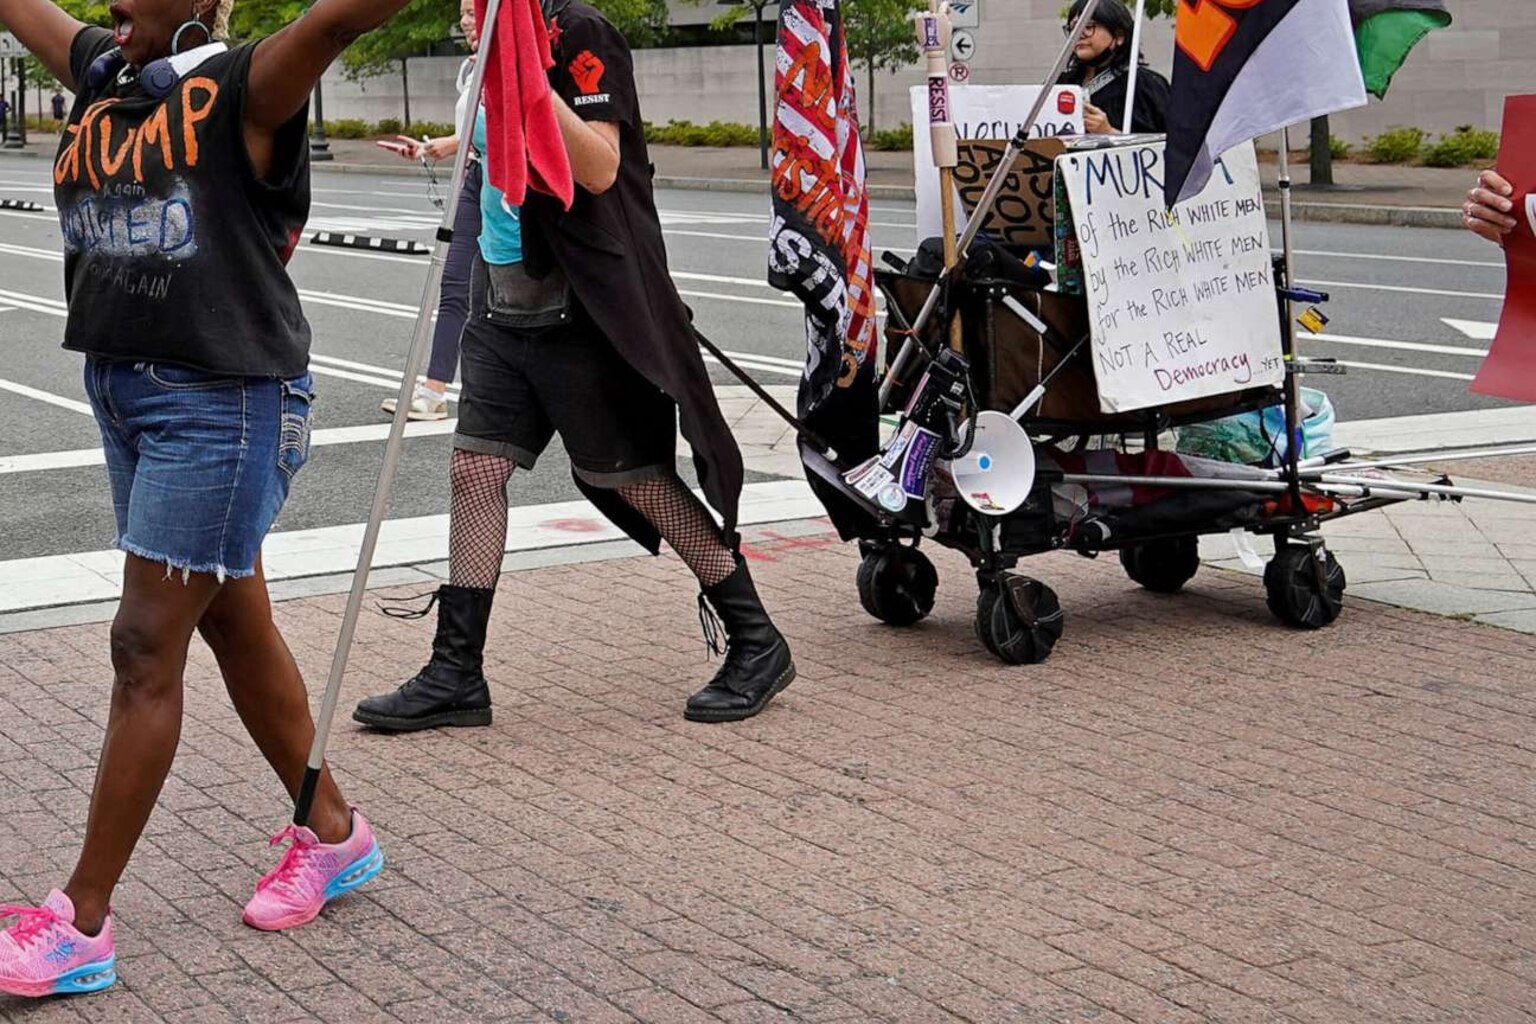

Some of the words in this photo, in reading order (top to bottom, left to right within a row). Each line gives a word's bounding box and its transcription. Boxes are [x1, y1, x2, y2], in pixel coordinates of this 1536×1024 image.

[574, 93, 611, 106] RESIST
[929, 77, 947, 123] RESIST
[1080, 212, 1098, 258] of
[1108, 211, 1138, 242] the
[1147, 208, 1181, 233] RICH
[1187, 200, 1230, 226] WHITE
[1234, 192, 1262, 218] MEN
[113, 267, 172, 300] AGAIN
[1088, 264, 1109, 306] by
[1114, 260, 1138, 280] the
[1144, 246, 1180, 274] RICH
[1182, 237, 1223, 263] WHITE
[1231, 231, 1263, 256] MEN
[1094, 302, 1119, 346] for
[1126, 299, 1149, 324] the
[1152, 288, 1188, 317] RICH
[1194, 276, 1228, 302] WHITE
[1234, 261, 1269, 294] MEN
[1098, 344, 1132, 376] NOT
[1144, 341, 1159, 369] A
[1163, 328, 1208, 359] REAL
[1154, 352, 1252, 391] Democracy
